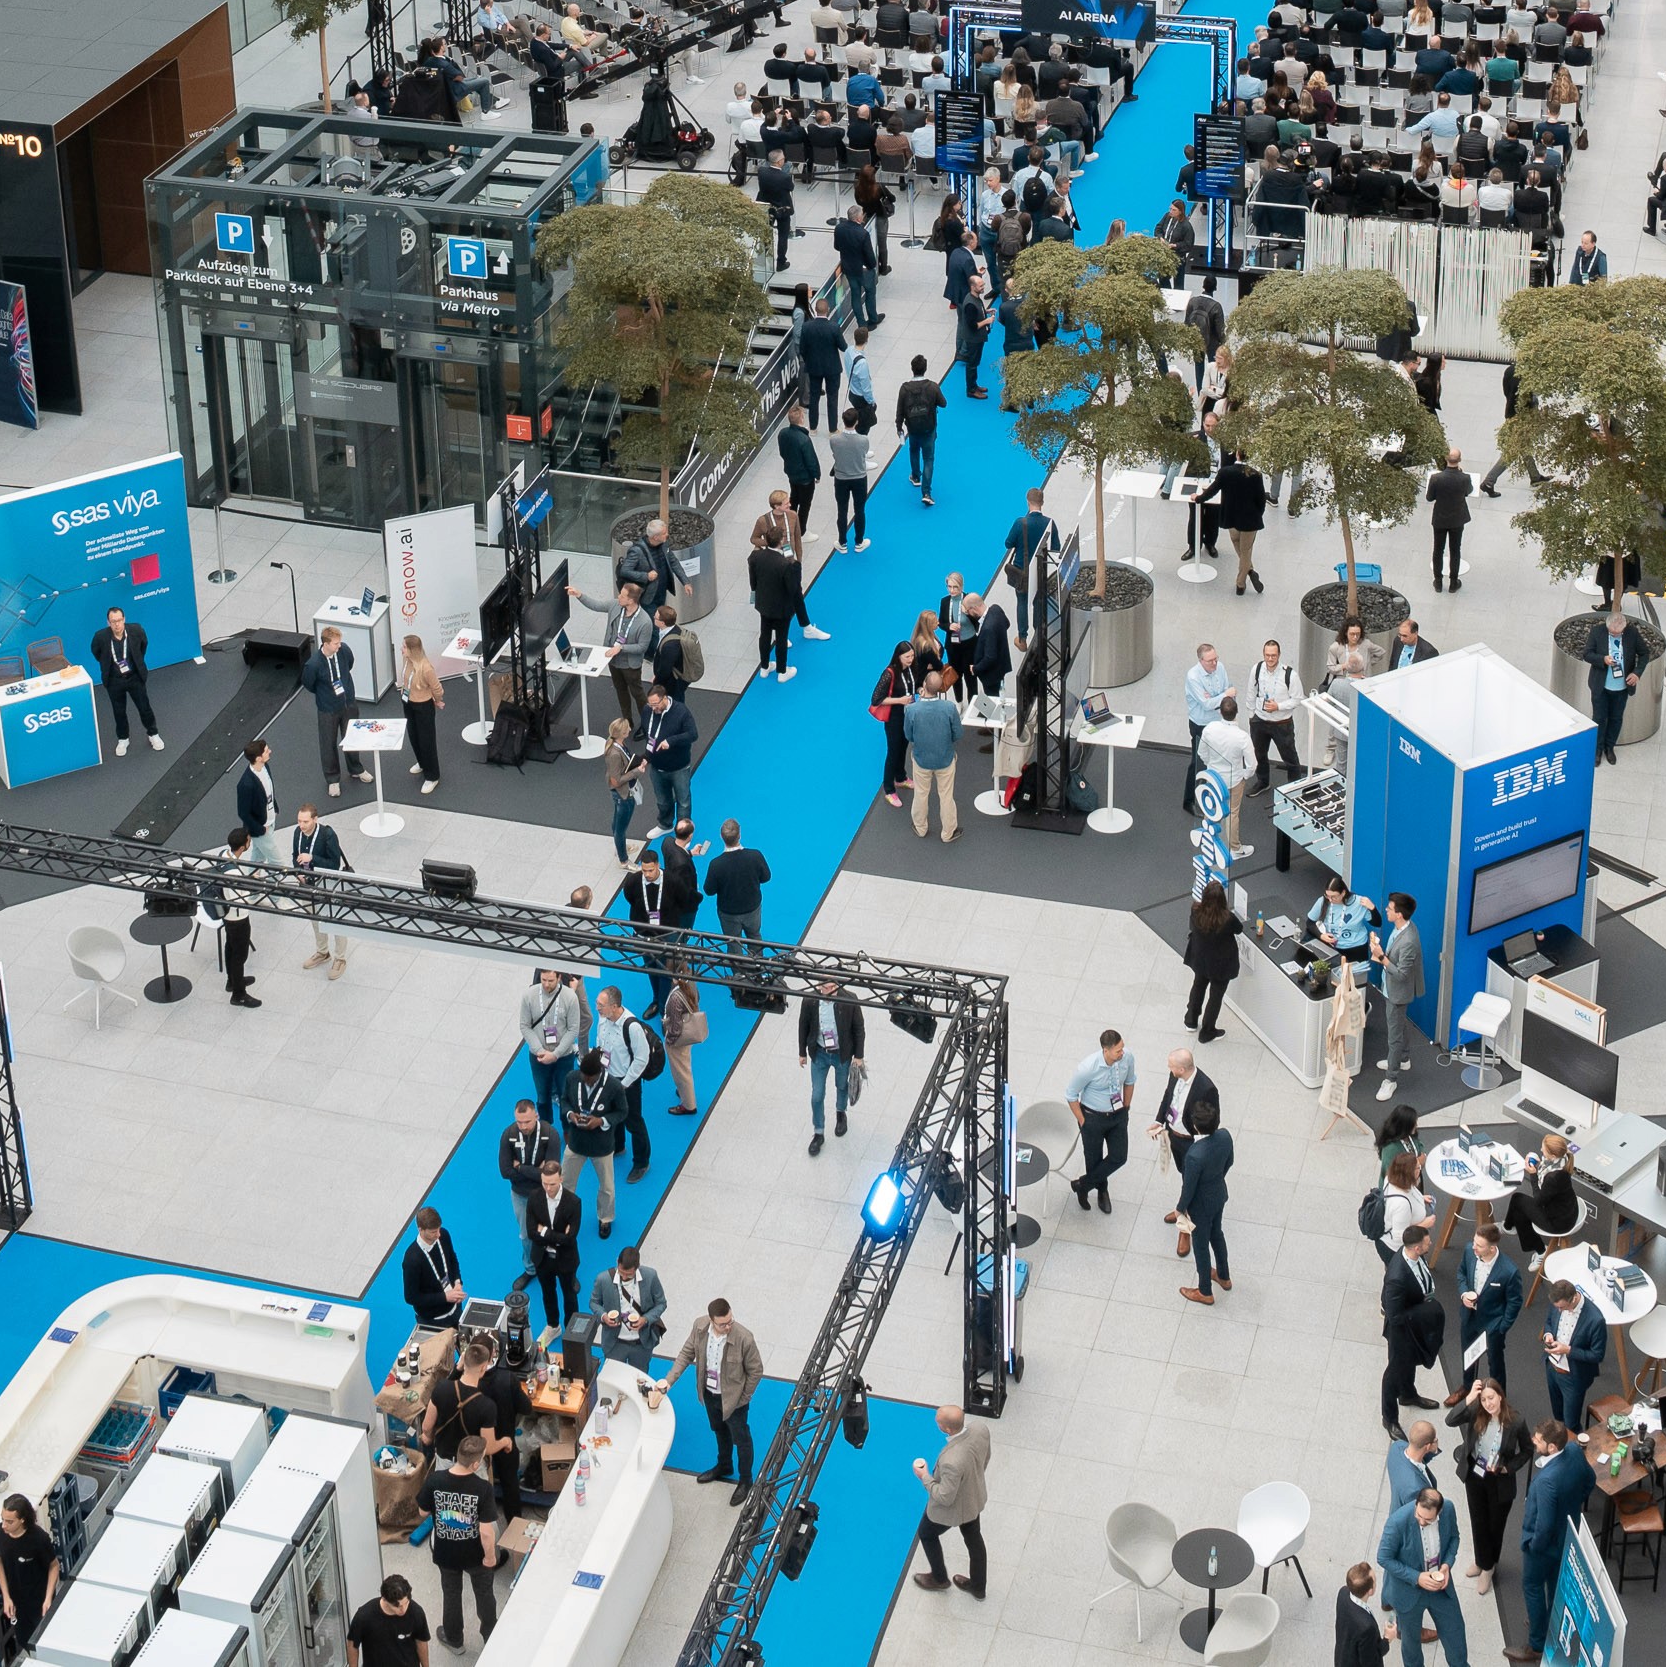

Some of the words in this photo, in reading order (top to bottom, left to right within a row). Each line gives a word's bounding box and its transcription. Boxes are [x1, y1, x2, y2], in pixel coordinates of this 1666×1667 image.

[1059, 10, 1072, 21] AI
[1074, 12, 1118, 24] ARENA
[188, 129, 207, 139] WEST
[227, 221, 243, 244] P
[197, 258, 248, 276] Aufzüge
[252, 266, 278, 277] zum
[460, 249, 476, 272] P
[165, 269, 221, 285] Parkdeck
[225, 276, 245, 288] auf
[247, 278, 286, 293] Ebene
[289, 283, 314, 296] 3+4
[440, 284, 499, 301] Parkhaus
[1, 310, 14, 321] Data
[441, 301, 459, 312] via
[462, 302, 500, 316] Metro
[309, 377, 328, 386] THE
[760, 380, 781, 414] This
[85, 539, 96, 547] Der
[96, 532, 125, 544] schnellste
[125, 527, 138, 537] Weg
[138, 525, 150, 533] von
[86, 545, 101, 554] einer
[101, 537, 126, 550] Milliarde
[126, 528, 166, 544] Datenpunkten
[94, 549, 112, 559] einem
[112, 541, 146, 555] Standpunkt.
[401, 527, 418, 618] Genow.ai
[133, 586, 170, 601] sas.com/viya
[1399, 736, 1421, 765] IBM
[1492, 750, 1567, 807] IBM
[1474, 831, 1496, 844] Govern
[1496, 826, 1508, 836] and
[1508, 820, 1523, 832] build
[1523, 817, 1537, 827] trust
[1474, 844, 1480, 852] in
[1480, 834, 1511, 851] generative
[1511, 831, 1519, 839] AI
[1574, 1009, 1592, 1023] DELL
[434, 1490, 479, 1506] STAFF
